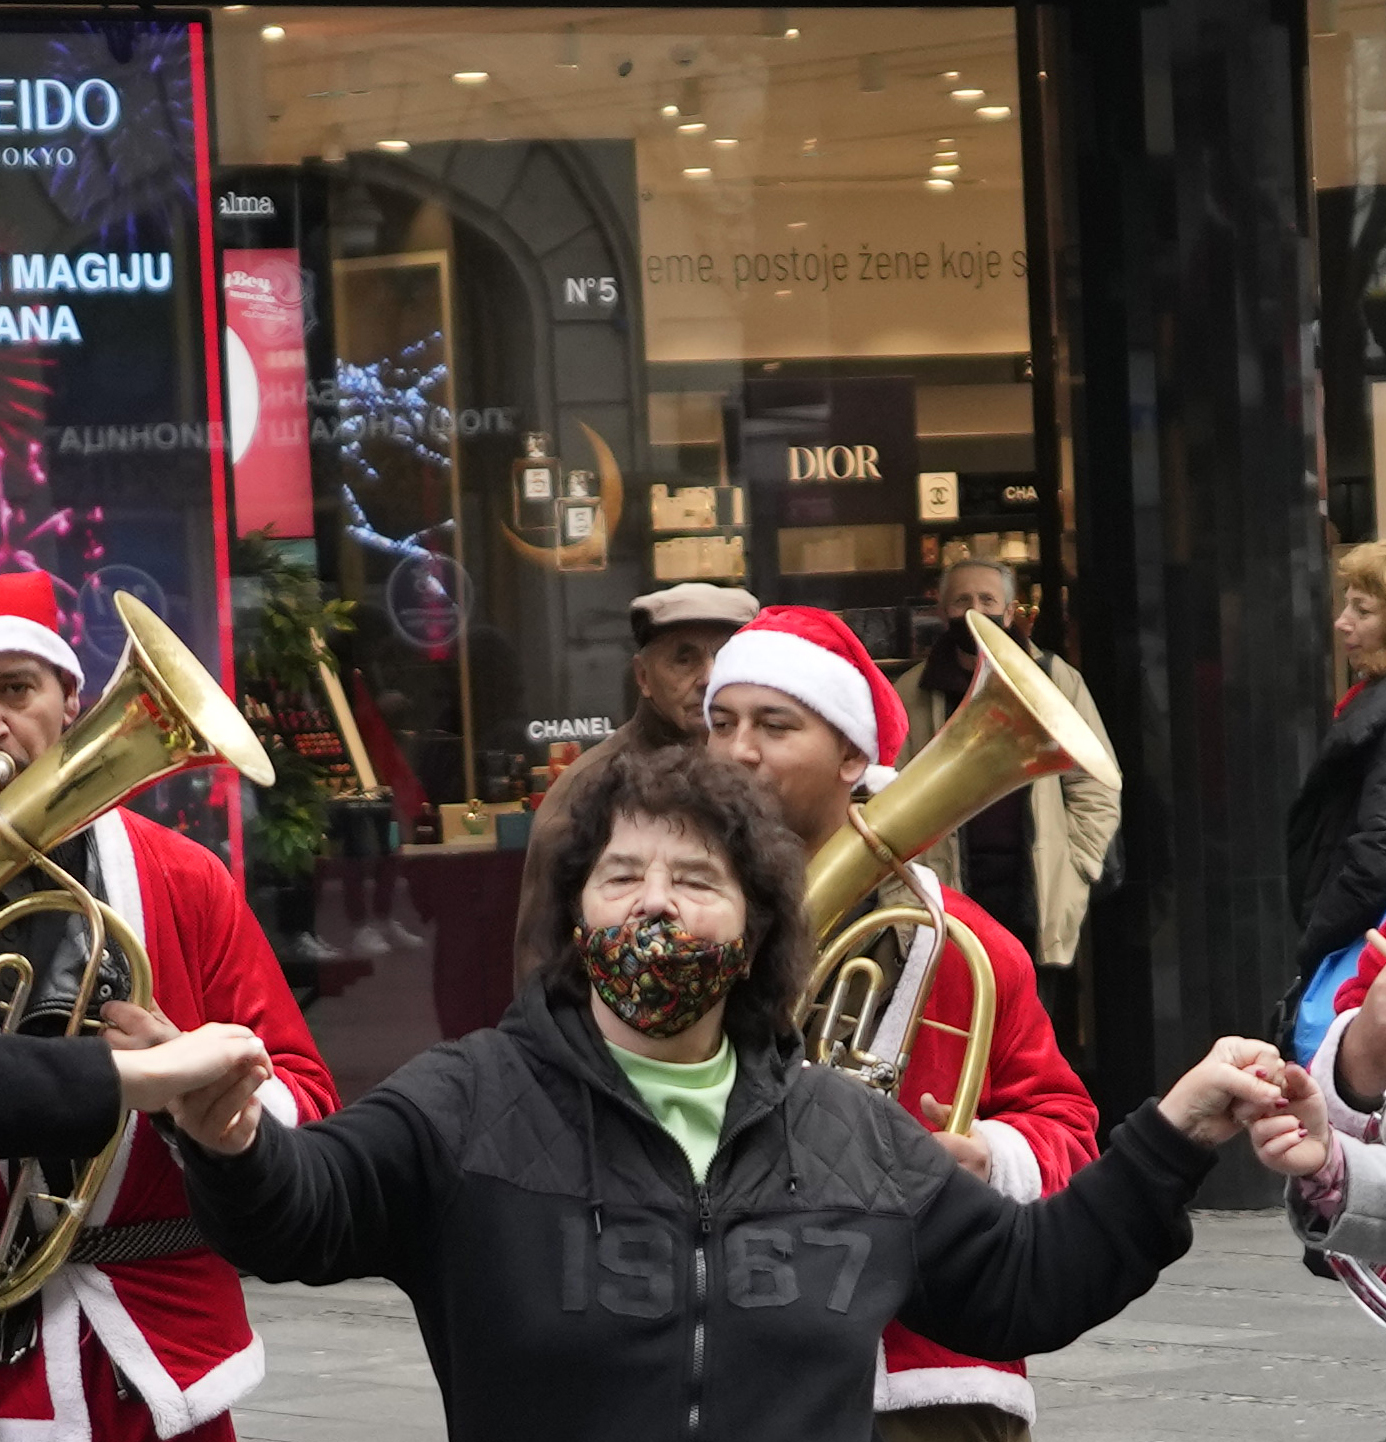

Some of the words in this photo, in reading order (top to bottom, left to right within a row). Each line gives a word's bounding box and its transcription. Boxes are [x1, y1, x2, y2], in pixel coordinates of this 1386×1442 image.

[11, 251, 173, 292] MAGIJU
[734, 243, 849, 292] postoje
[858, 242, 930, 281] žene
[940, 240, 1002, 290] koje
[787, 445, 882, 482] DIOR
[528, 716, 616, 739] CHANEL
